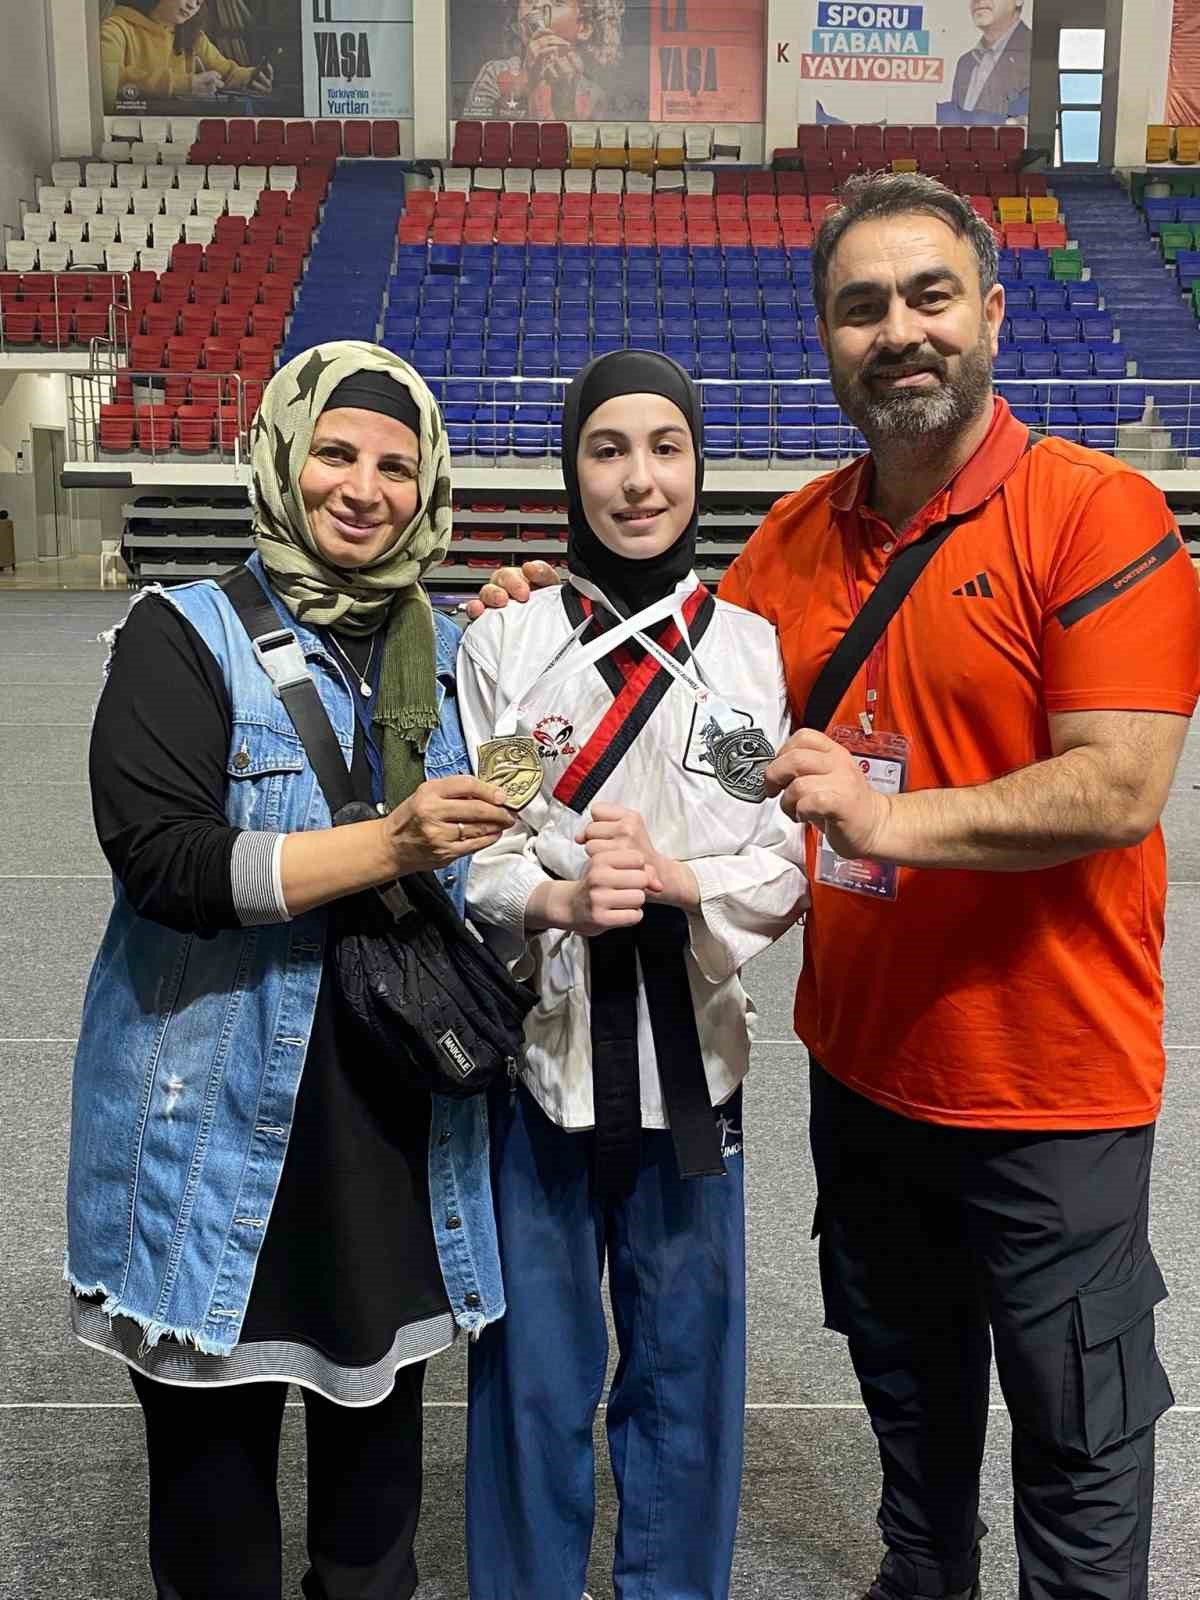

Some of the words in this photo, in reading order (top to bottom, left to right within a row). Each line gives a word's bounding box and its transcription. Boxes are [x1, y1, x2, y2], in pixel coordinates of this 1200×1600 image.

[827, 5, 909, 29] SPORU
[777, 43, 789, 62] K
[819, 32, 919, 53] TABANA
[313, 32, 371, 82] YAŞA
[804, 56, 940, 80] YAYIYORUZ
[659, 47, 718, 97] YAŞA
[328, 100, 369, 114] Yurtları
